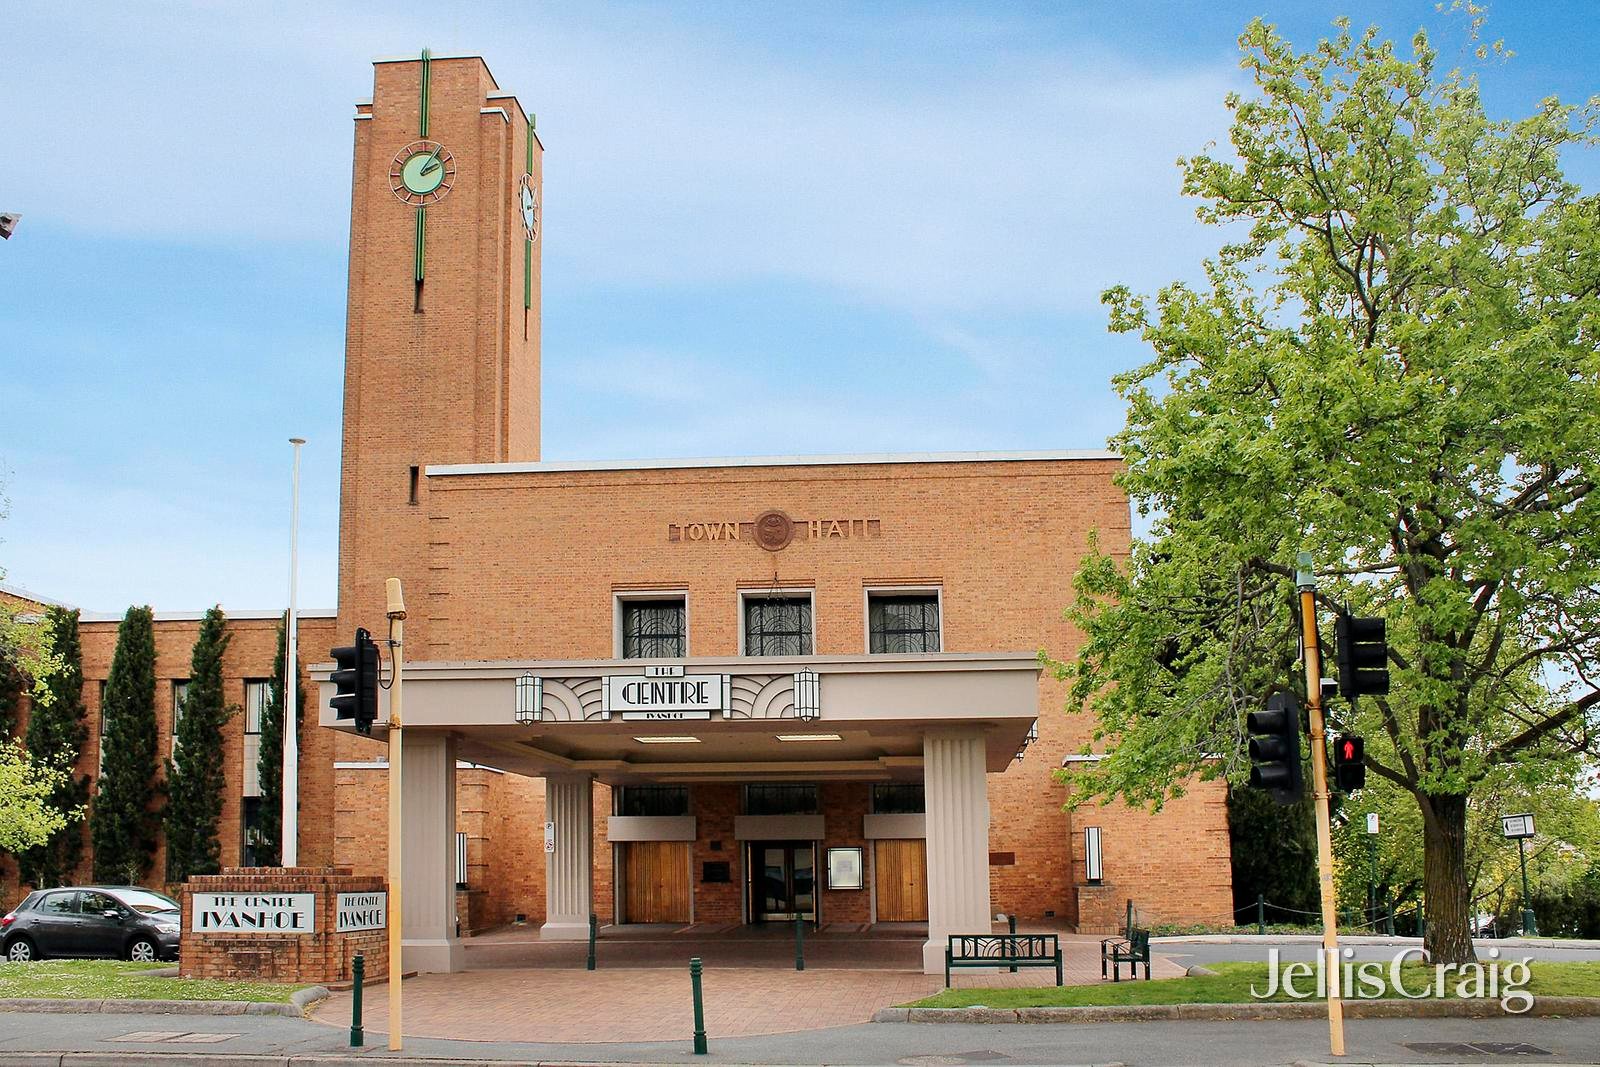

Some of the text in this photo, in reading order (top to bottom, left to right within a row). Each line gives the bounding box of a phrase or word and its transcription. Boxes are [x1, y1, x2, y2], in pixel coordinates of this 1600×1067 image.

[674, 519, 878, 541] TOWN HALL
[653, 667, 677, 676] THE
[622, 681, 709, 705] CENTRE
[212, 896, 296, 907] THE CENTRE
[201, 911, 305, 929] IVANHOE
[340, 909, 383, 928] IVANHOE
